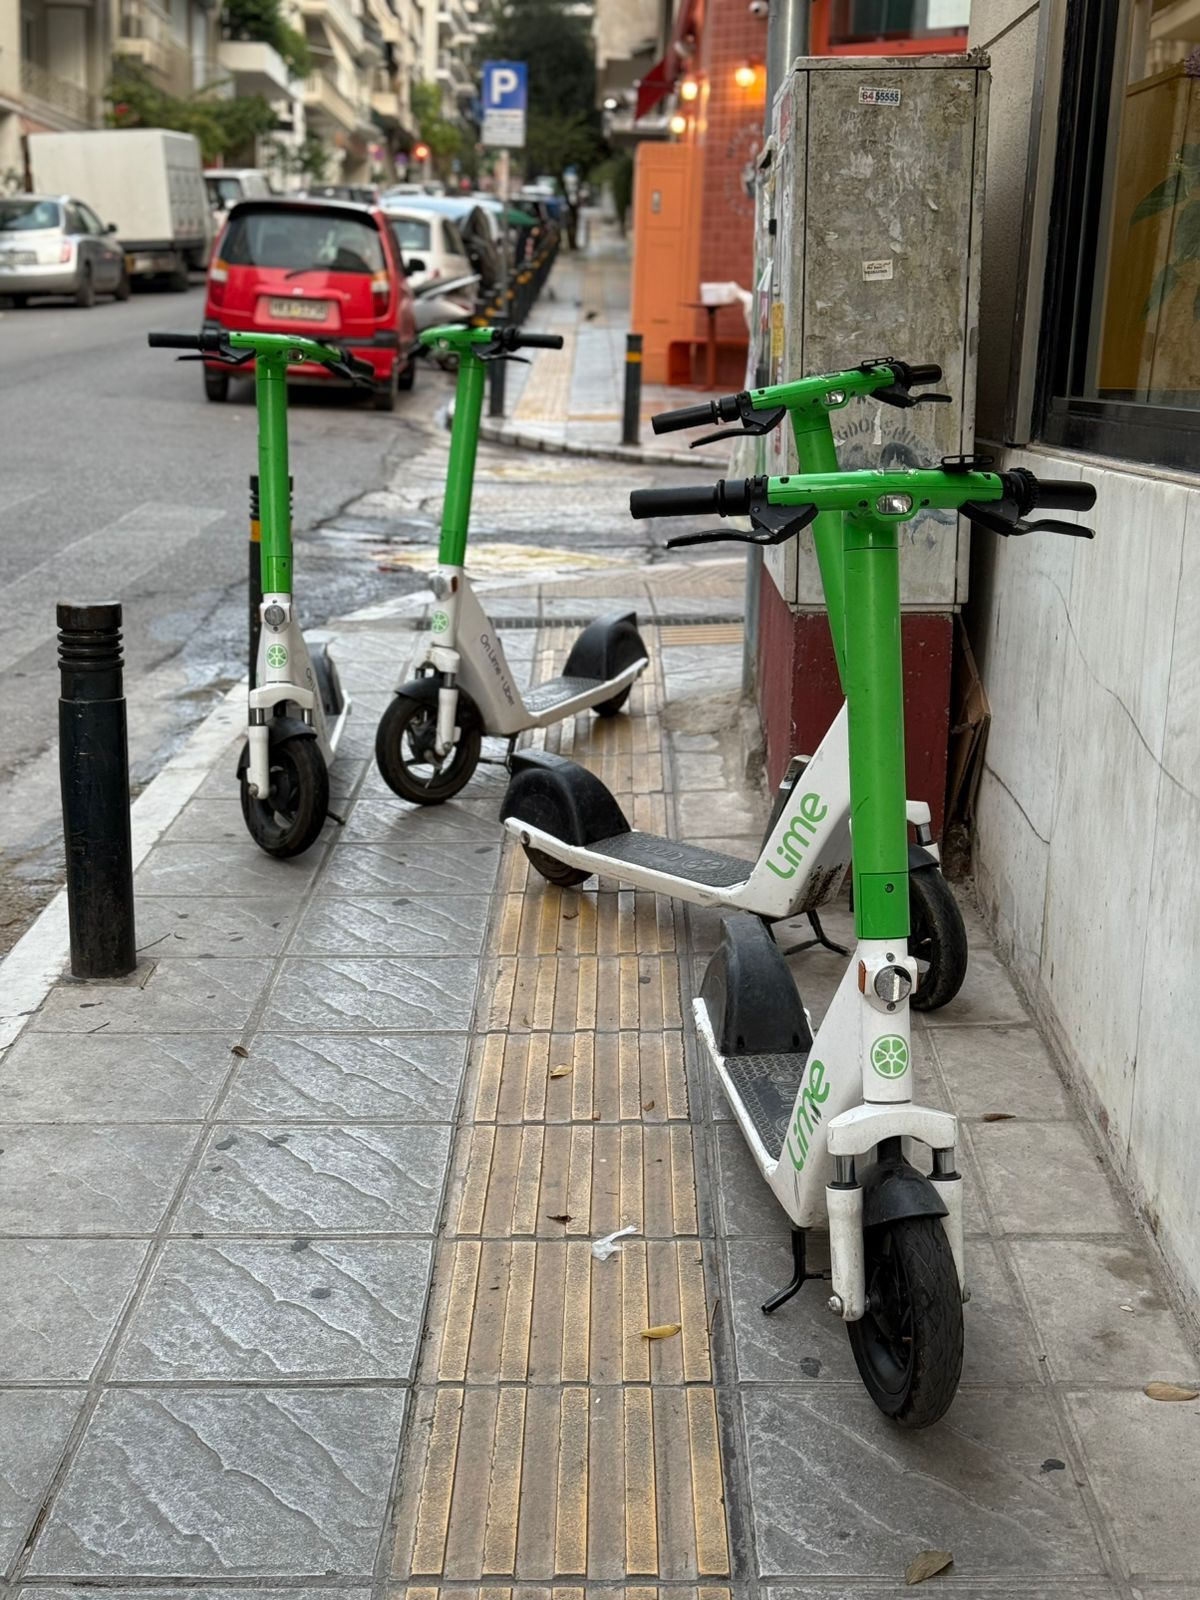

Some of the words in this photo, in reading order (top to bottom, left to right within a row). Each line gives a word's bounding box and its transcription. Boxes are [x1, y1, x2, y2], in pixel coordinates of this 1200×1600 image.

[491, 69, 518, 104] P
[862, 91, 875, 100] 64
[875, 91, 899, 102] 55555
[480, 634, 491, 652] On
[488, 649, 502, 676] Lime
[765, 792, 828, 880] Lime
[786, 1059, 830, 1171] Lime
